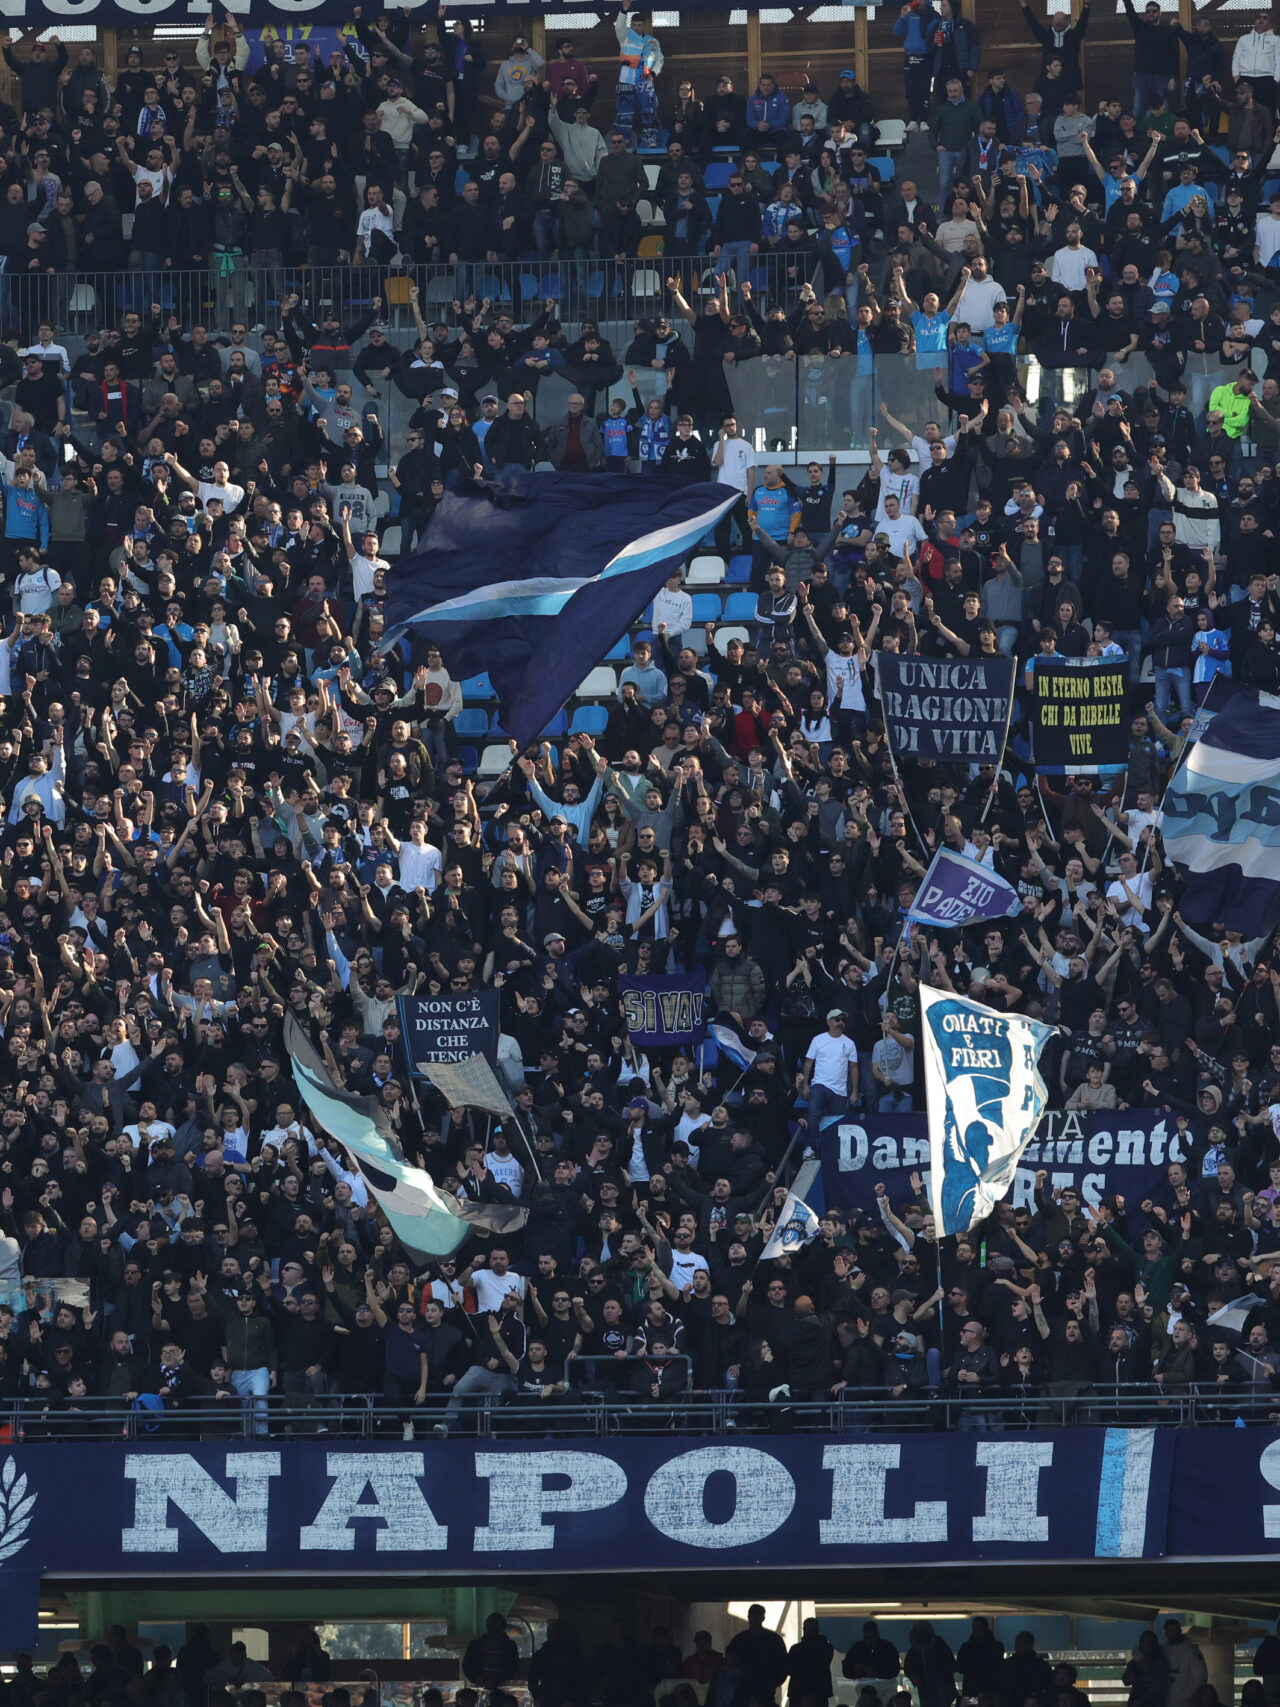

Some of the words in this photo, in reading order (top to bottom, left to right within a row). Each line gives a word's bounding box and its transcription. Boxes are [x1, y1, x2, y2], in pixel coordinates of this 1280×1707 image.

[991, 335, 1009, 344] MSC
[607, 427, 626, 437] Lete
[16, 498, 37, 511] Lete
[759, 496, 780, 506] Lete
[899, 661, 988, 690] UNICA
[1038, 676, 1049, 697] IN
[1052, 675, 1091, 699] ETERNO
[1093, 674, 1124, 698] RESTA
[886, 692, 1008, 724] RAGIONE
[1041, 705, 1059, 726] CHI
[1063, 705, 1078, 726] DA
[1079, 703, 1121, 725] RIBELLE
[894, 725, 919, 751] DI
[932, 729, 998, 756] VITA
[1069, 733, 1093, 755] VIVE
[960, 875, 995, 908] ZIO
[418, 1000, 460, 1014] NON
[415, 1016, 490, 1032] DISTANZA
[436, 1034, 469, 1048] CHE
[963, 1034, 974, 1049] E
[427, 1050, 479, 1064] TENGA
[951, 1047, 1003, 1069] FIERI
[1080, 1046, 1099, 1057] MSC
[493, 1168, 518, 1178] AKERS
[122, 1442, 1054, 1552] NAPOLI
